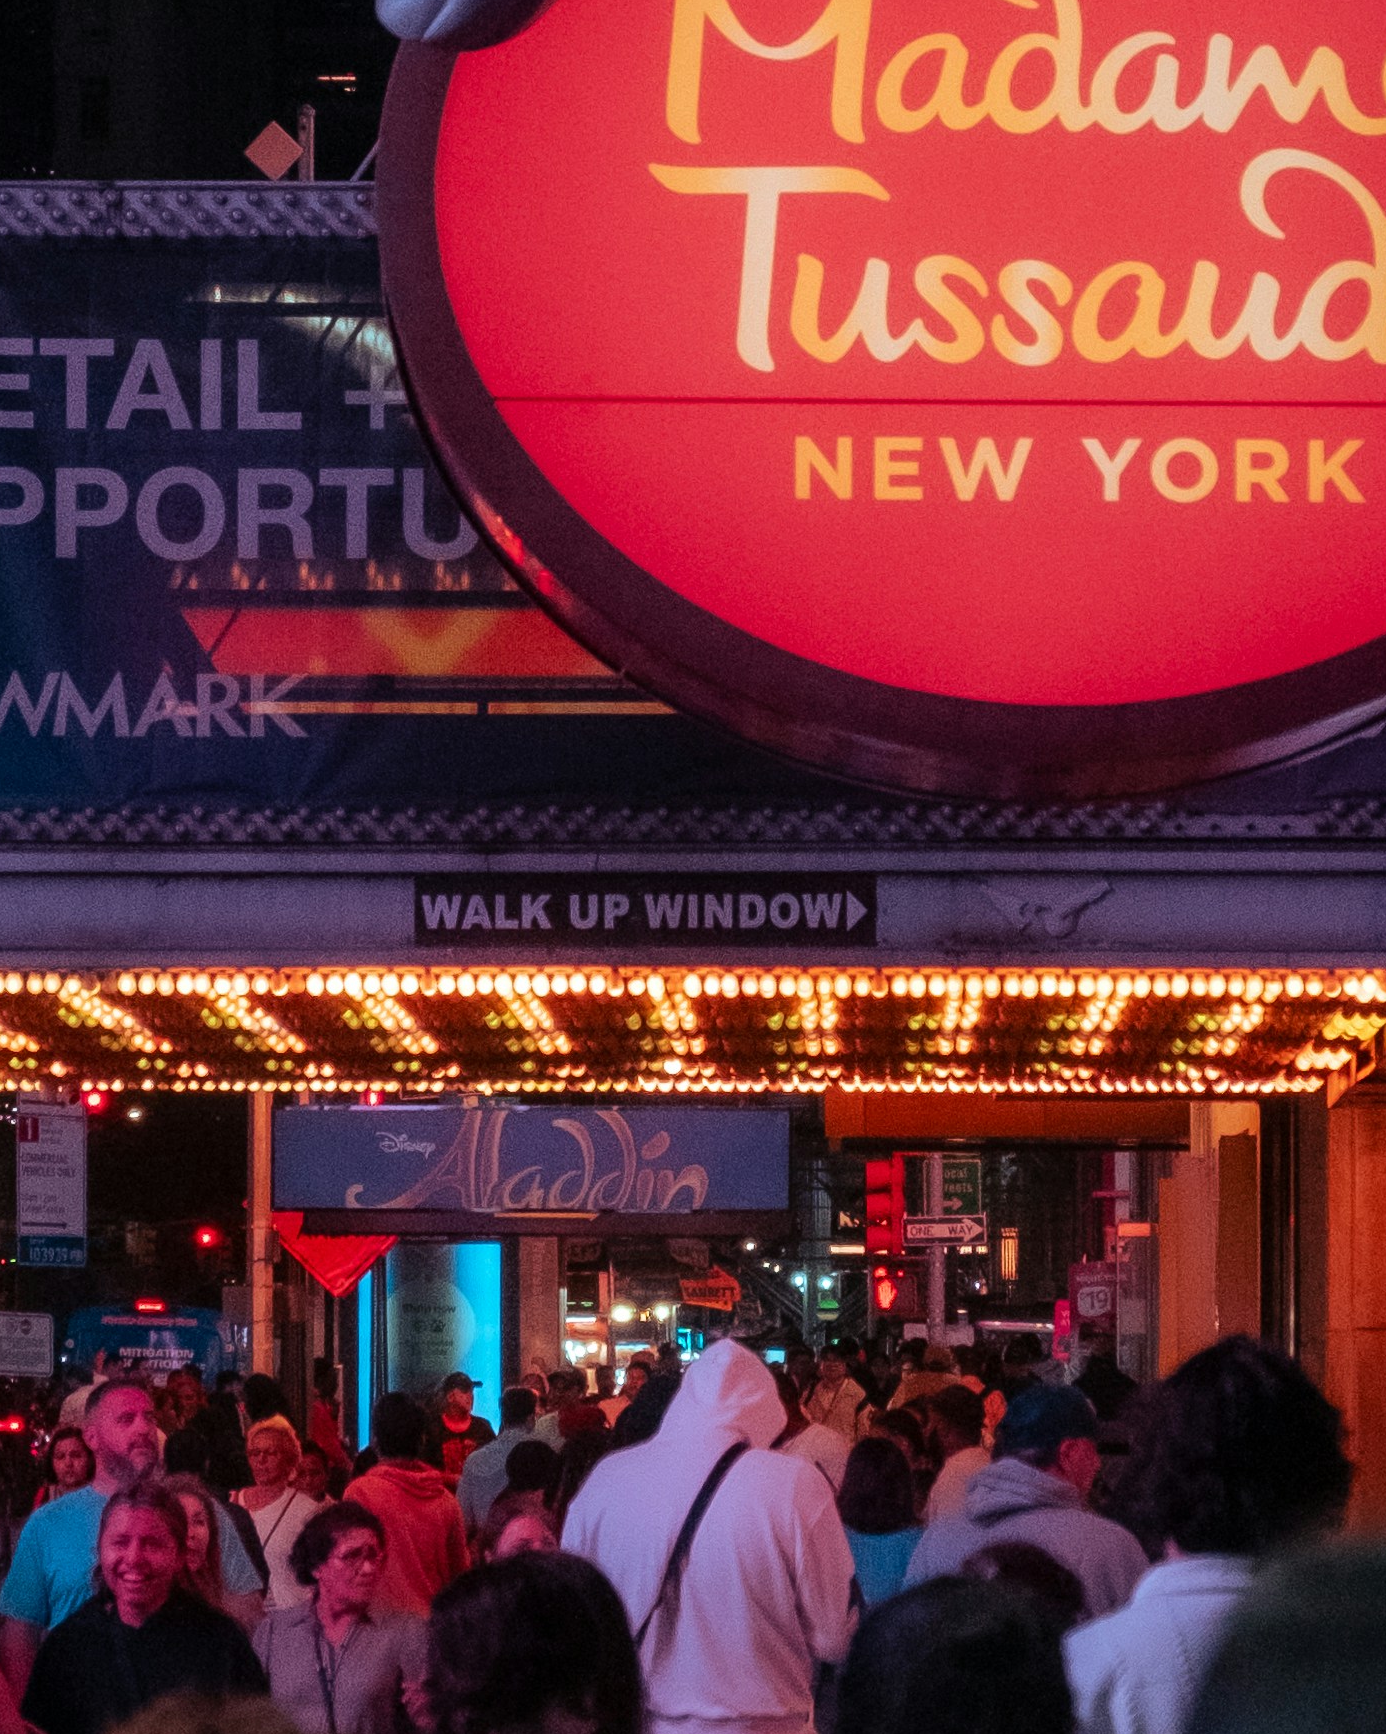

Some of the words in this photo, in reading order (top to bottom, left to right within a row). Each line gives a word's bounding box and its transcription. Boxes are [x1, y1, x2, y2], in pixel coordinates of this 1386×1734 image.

[794, 435, 1033, 502] NEW
[1081, 437, 1366, 504] YORK
[422, 894, 553, 930] WALK
[569, 894, 629, 930] UP
[644, 891, 847, 930] WINDOW
[344, 1107, 710, 1211] Aladdin
[909, 1225, 932, 1237] ONE
[948, 1224, 973, 1236] WAY
